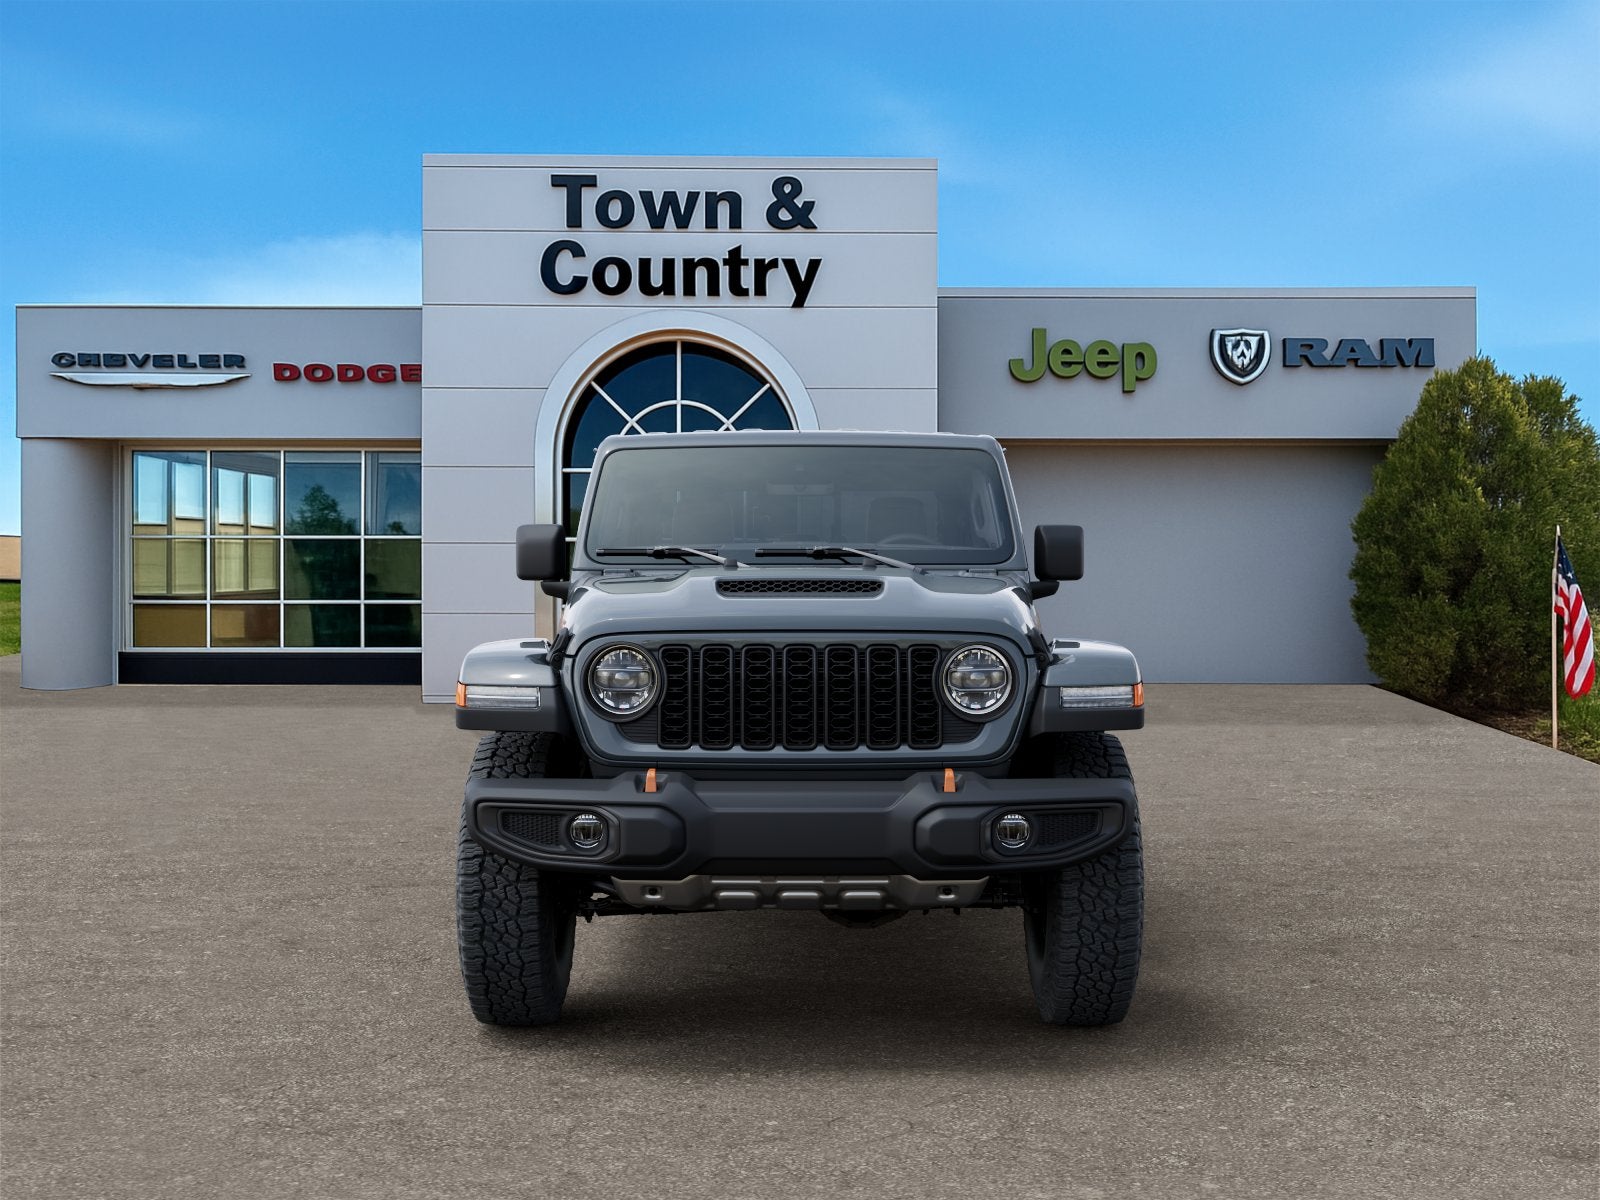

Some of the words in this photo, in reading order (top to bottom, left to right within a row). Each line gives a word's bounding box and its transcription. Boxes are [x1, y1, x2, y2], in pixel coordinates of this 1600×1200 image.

[550, 174, 742, 230] Town
[765, 175, 818, 230] &
[540, 239, 822, 308] Country
[272, 362, 422, 383] DODGE
[1009, 328, 1157, 393] Jeep
[1282, 337, 1435, 368] RAM
